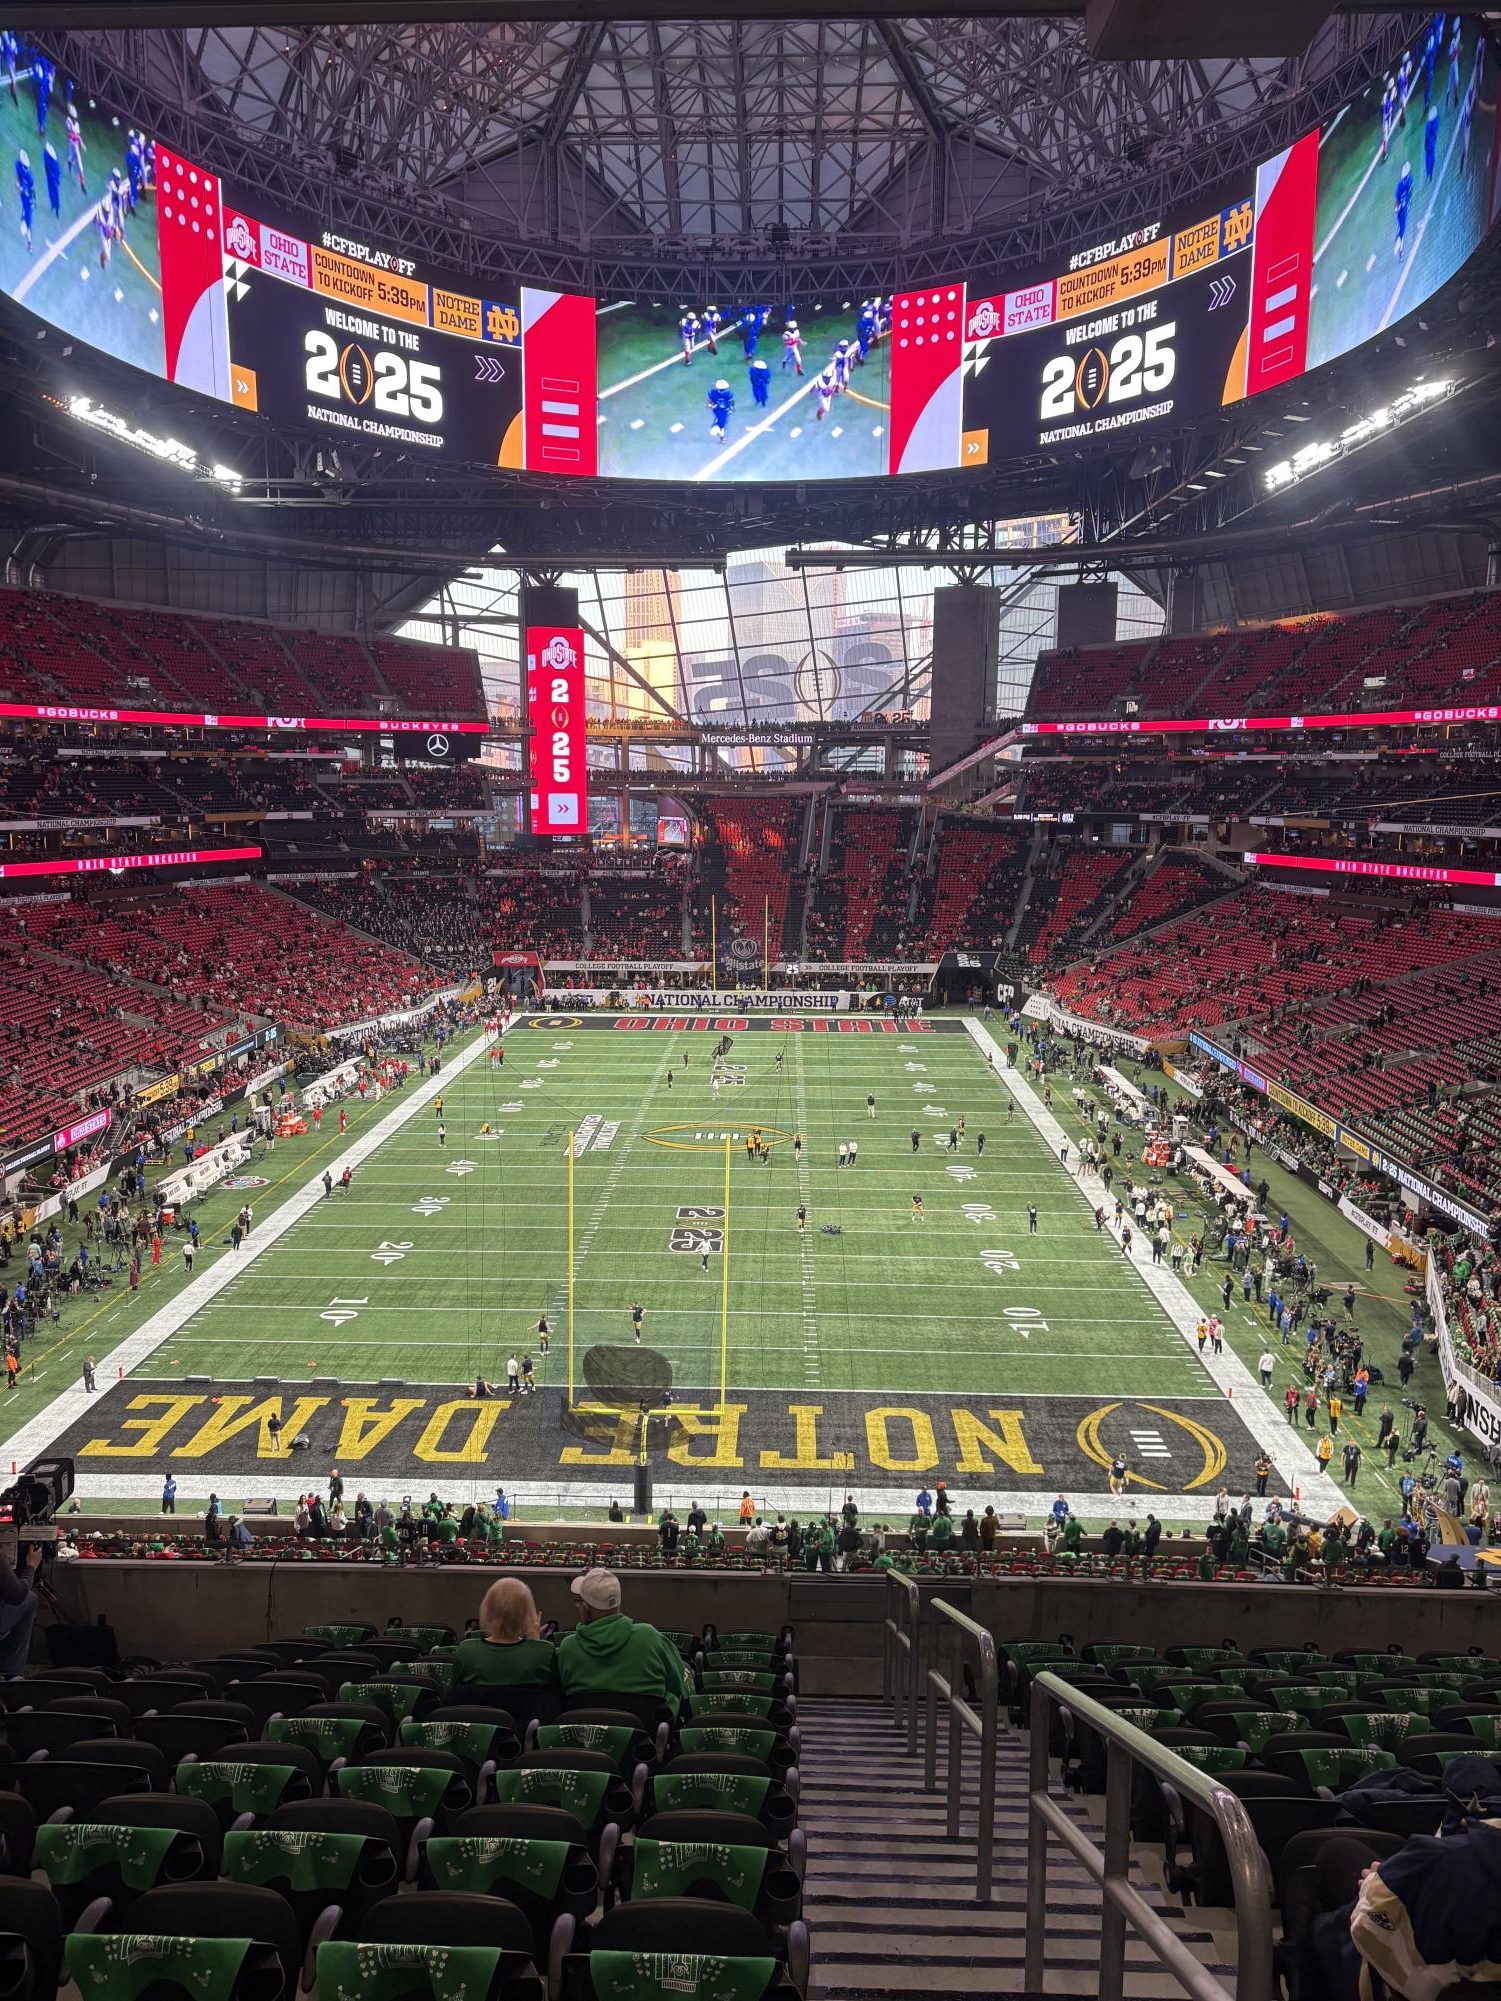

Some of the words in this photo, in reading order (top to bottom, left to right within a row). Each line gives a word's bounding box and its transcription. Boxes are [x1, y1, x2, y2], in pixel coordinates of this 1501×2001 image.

[269, 233, 299, 258] OHIO
[1177, 221, 1218, 253] NOTRE
[263, 250, 307, 280] STATE
[1179, 242, 1215, 269] DAME
[315, 253, 375, 285] COUNTDOWN
[1060, 264, 1119, 295] COUNTDOWN
[318, 271, 331, 287] TO
[332, 276, 373, 302] KICKOFF
[1061, 297, 1074, 311] TO
[1075, 283, 1116, 307] KICKOFF
[436, 293, 480, 316] NOTRE
[1014, 289, 1045, 309] OHIO
[439, 310, 477, 332] DAME
[1007, 304, 1050, 327] STATE
[1066, 315, 1118, 345] WELCOME
[1120, 309, 1135, 328] TO
[1137, 301, 1157, 323] THE
[325, 307, 379, 341] WELCOME
[382, 326, 395, 345] TO
[398, 330, 420, 351] THE
[307, 405, 361, 431] NATIONAL
[363, 419, 443, 447] CHAMPIONSHIP
[1039, 418, 1094, 445] NATIONAL
[1095, 400, 1174, 433] CHAMPIONSHIP
[37, 707, 118, 720] #GOBUCKS
[1414, 707, 1498, 721] #GOBUCKS
[380, 721, 460, 731] BUCKEYES
[1057, 722, 1141, 731] #GOBUCKS
[701, 733, 772, 744] Mercedes-Benz
[773, 733, 813, 743] Stadium
[37, 820, 70, 828] NATIONAL
[70, 818, 117, 827] CHAMPIONSHIP
[1403, 825, 1433, 834] NATIONAL
[1435, 826, 1486, 836] CHAMPIONSHIP
[78, 859, 104, 870] OHIO
[111, 856, 142, 868] STATE
[149, 852, 197, 865] BUCKEYES
[1335, 861, 1357, 871] OHIO
[1362, 863, 1390, 875] STATE
[1396, 866, 1448, 880] BUCKEYES
[725, 959, 765, 970] Allstate
[786, 964, 799, 975] 25
[819, 964, 847, 972] COLLEGE
[849, 965, 886, 973] FOOTBALL
[888, 965, 918, 973] PLAYOFF
[646, 992, 719, 1008] NATIONAL
[722, 992, 839, 1008] CHAMPIONSHIP
[997, 984, 1014, 1003] CFP
[613, 1017, 750, 1032] OHIO
[771, 1018, 937, 1033] STATE
[1071, 1022, 1135, 1050] CHAMPIONSHIP
[1268, 1082, 1293, 1108] COUNTDOWN
[1291, 1098, 1299, 1112] TO
[87, 1113, 106, 1132] STATE
[1318, 1179, 1333, 1199] ESPN
[1398, 1168, 1432, 1202] NATIONAL
[411, 1196, 450, 1213] 30
[960, 1203, 997, 1221] 30
[370, 1241, 414, 1261] 20
[979, 1249, 1021, 1271] 20
[320, 1296, 369, 1321] 10
[1002, 1306, 1050, 1333] 10
[77, 1394, 512, 1463] DAME
[559, 1400, 1045, 1474] NOTRE
